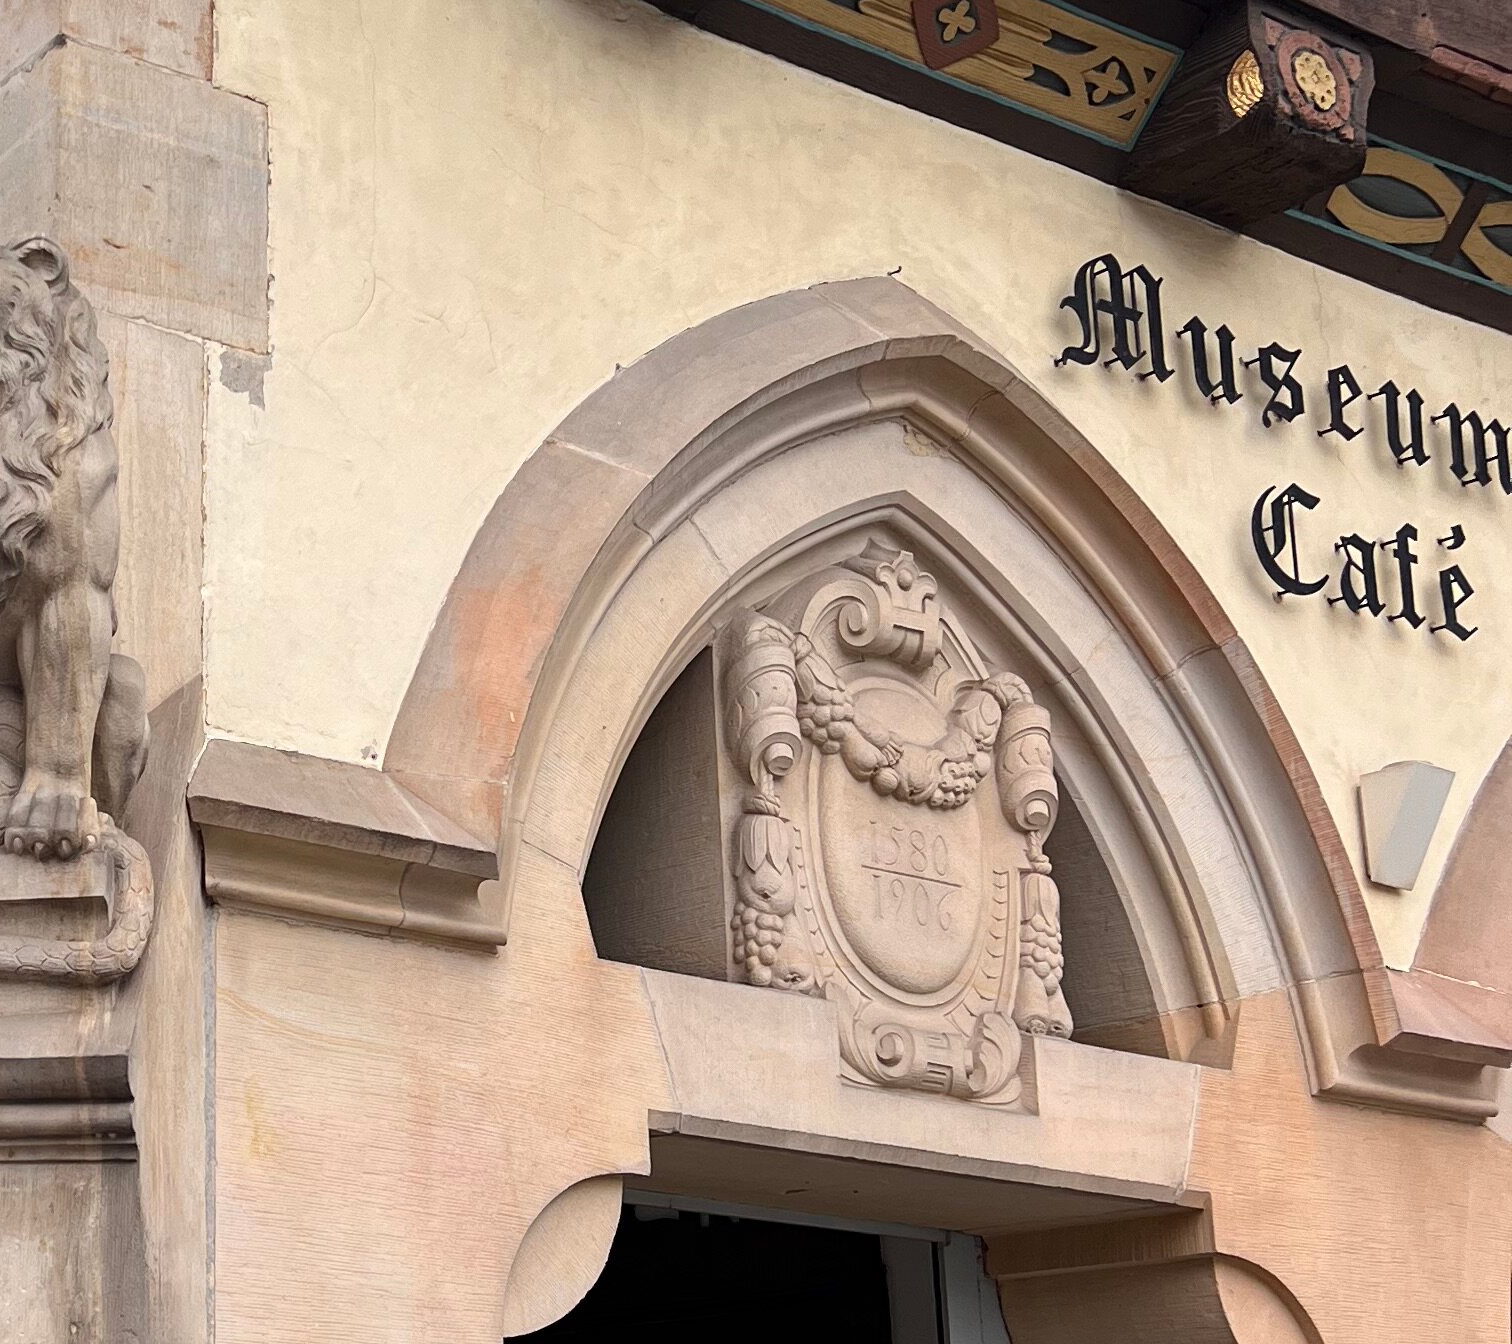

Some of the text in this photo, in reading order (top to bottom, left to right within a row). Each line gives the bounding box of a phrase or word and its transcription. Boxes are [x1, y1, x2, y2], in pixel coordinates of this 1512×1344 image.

[1059, 253, 1512, 495] Museum
[1251, 482, 1478, 642] Café
[869, 820, 949, 876] 1580
[872, 874, 958, 931] 1906
